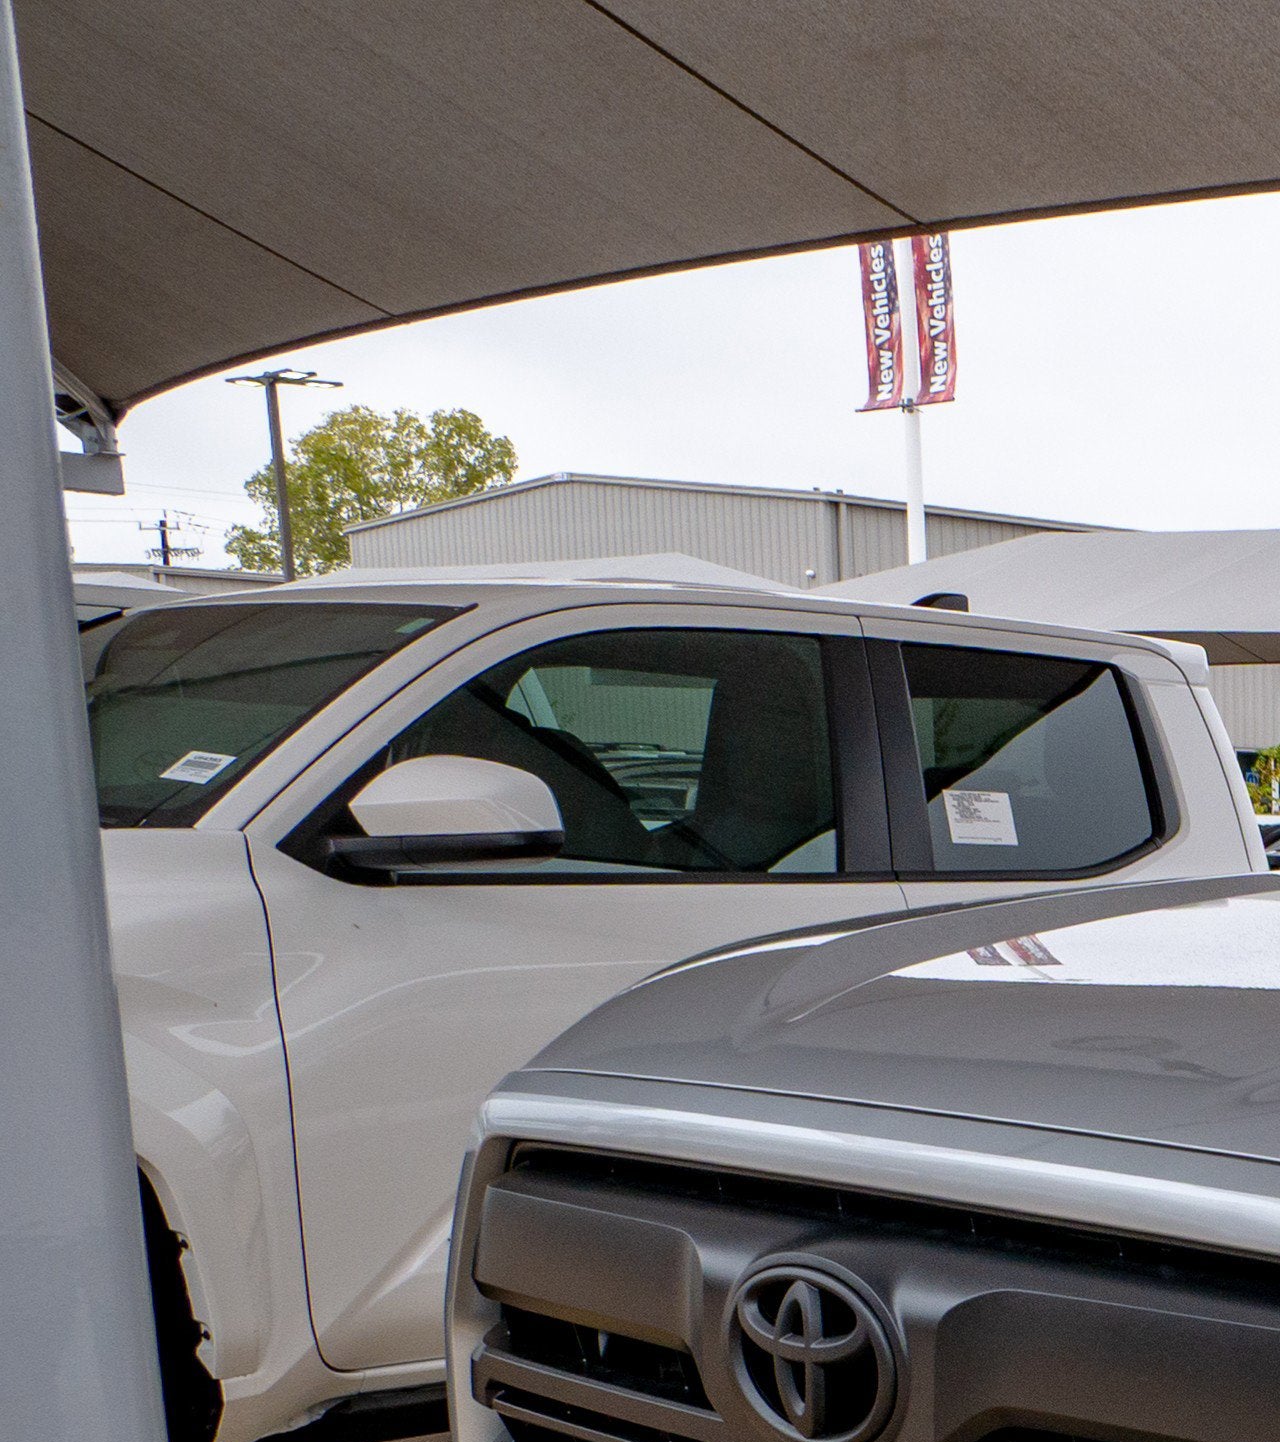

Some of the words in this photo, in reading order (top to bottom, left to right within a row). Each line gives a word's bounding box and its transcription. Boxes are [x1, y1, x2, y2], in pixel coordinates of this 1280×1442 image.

[869, 244, 892, 346] Vehicles
[925, 233, 946, 338] Vehicles
[876, 349, 895, 402] New
[929, 341, 950, 394] New
